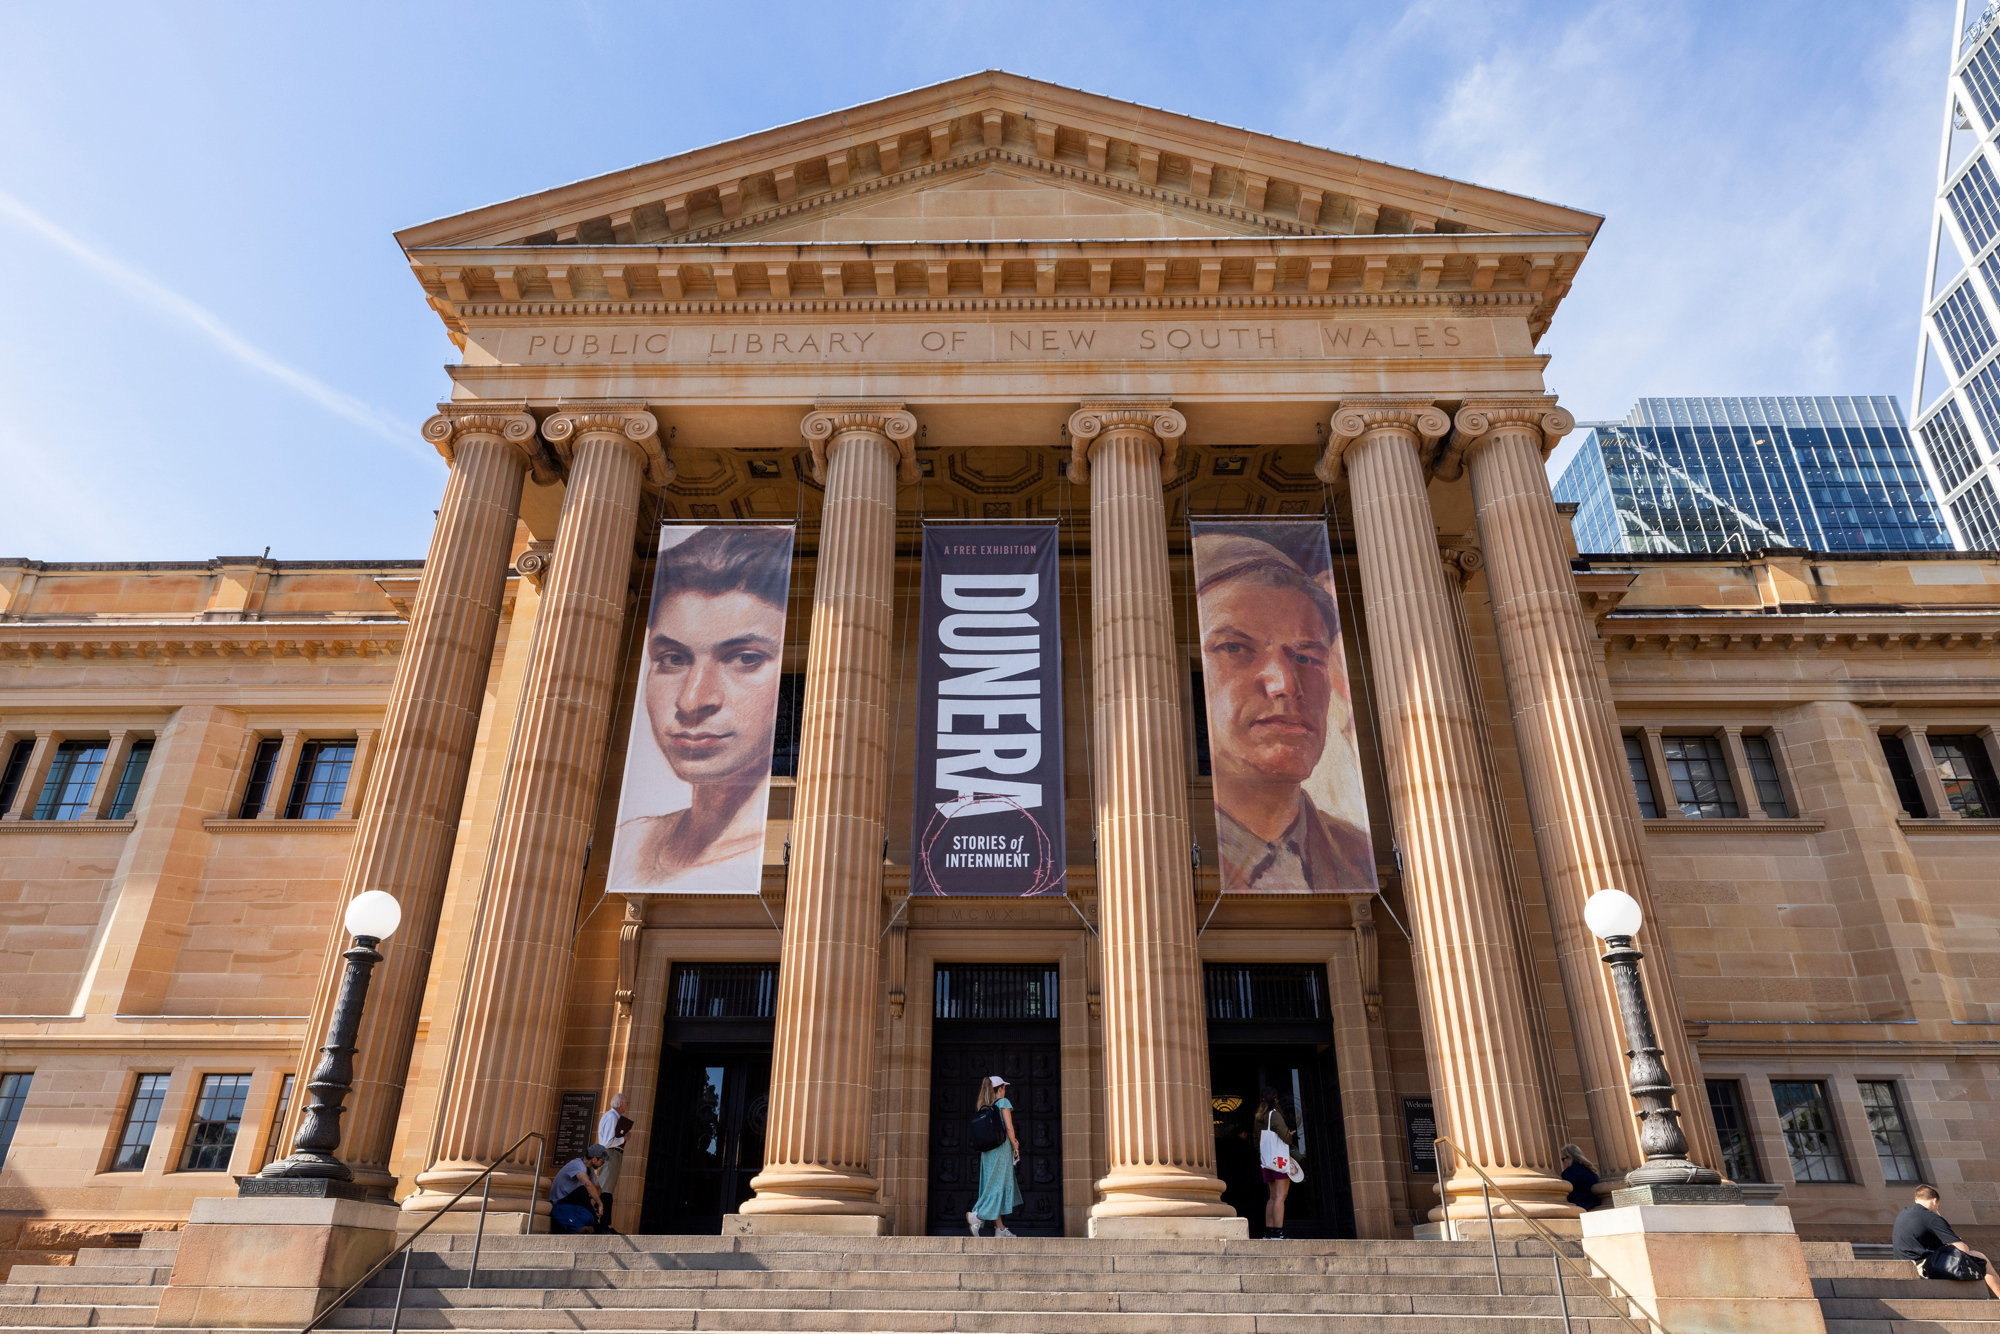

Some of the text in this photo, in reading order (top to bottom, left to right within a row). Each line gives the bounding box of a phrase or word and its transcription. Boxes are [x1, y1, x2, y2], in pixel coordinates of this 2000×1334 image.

[529, 325, 1461, 356] PUBLIC LIBRARY OF NEW SOUTH WALES
[944, 545, 1037, 555] A FREE EXHIBITION
[935, 573, 1042, 819] DUNERA
[953, 835, 1025, 854] STORIES of
[945, 853, 1030, 868] INTERNMENT
[1406, 1100, 1432, 1108] Welcom
